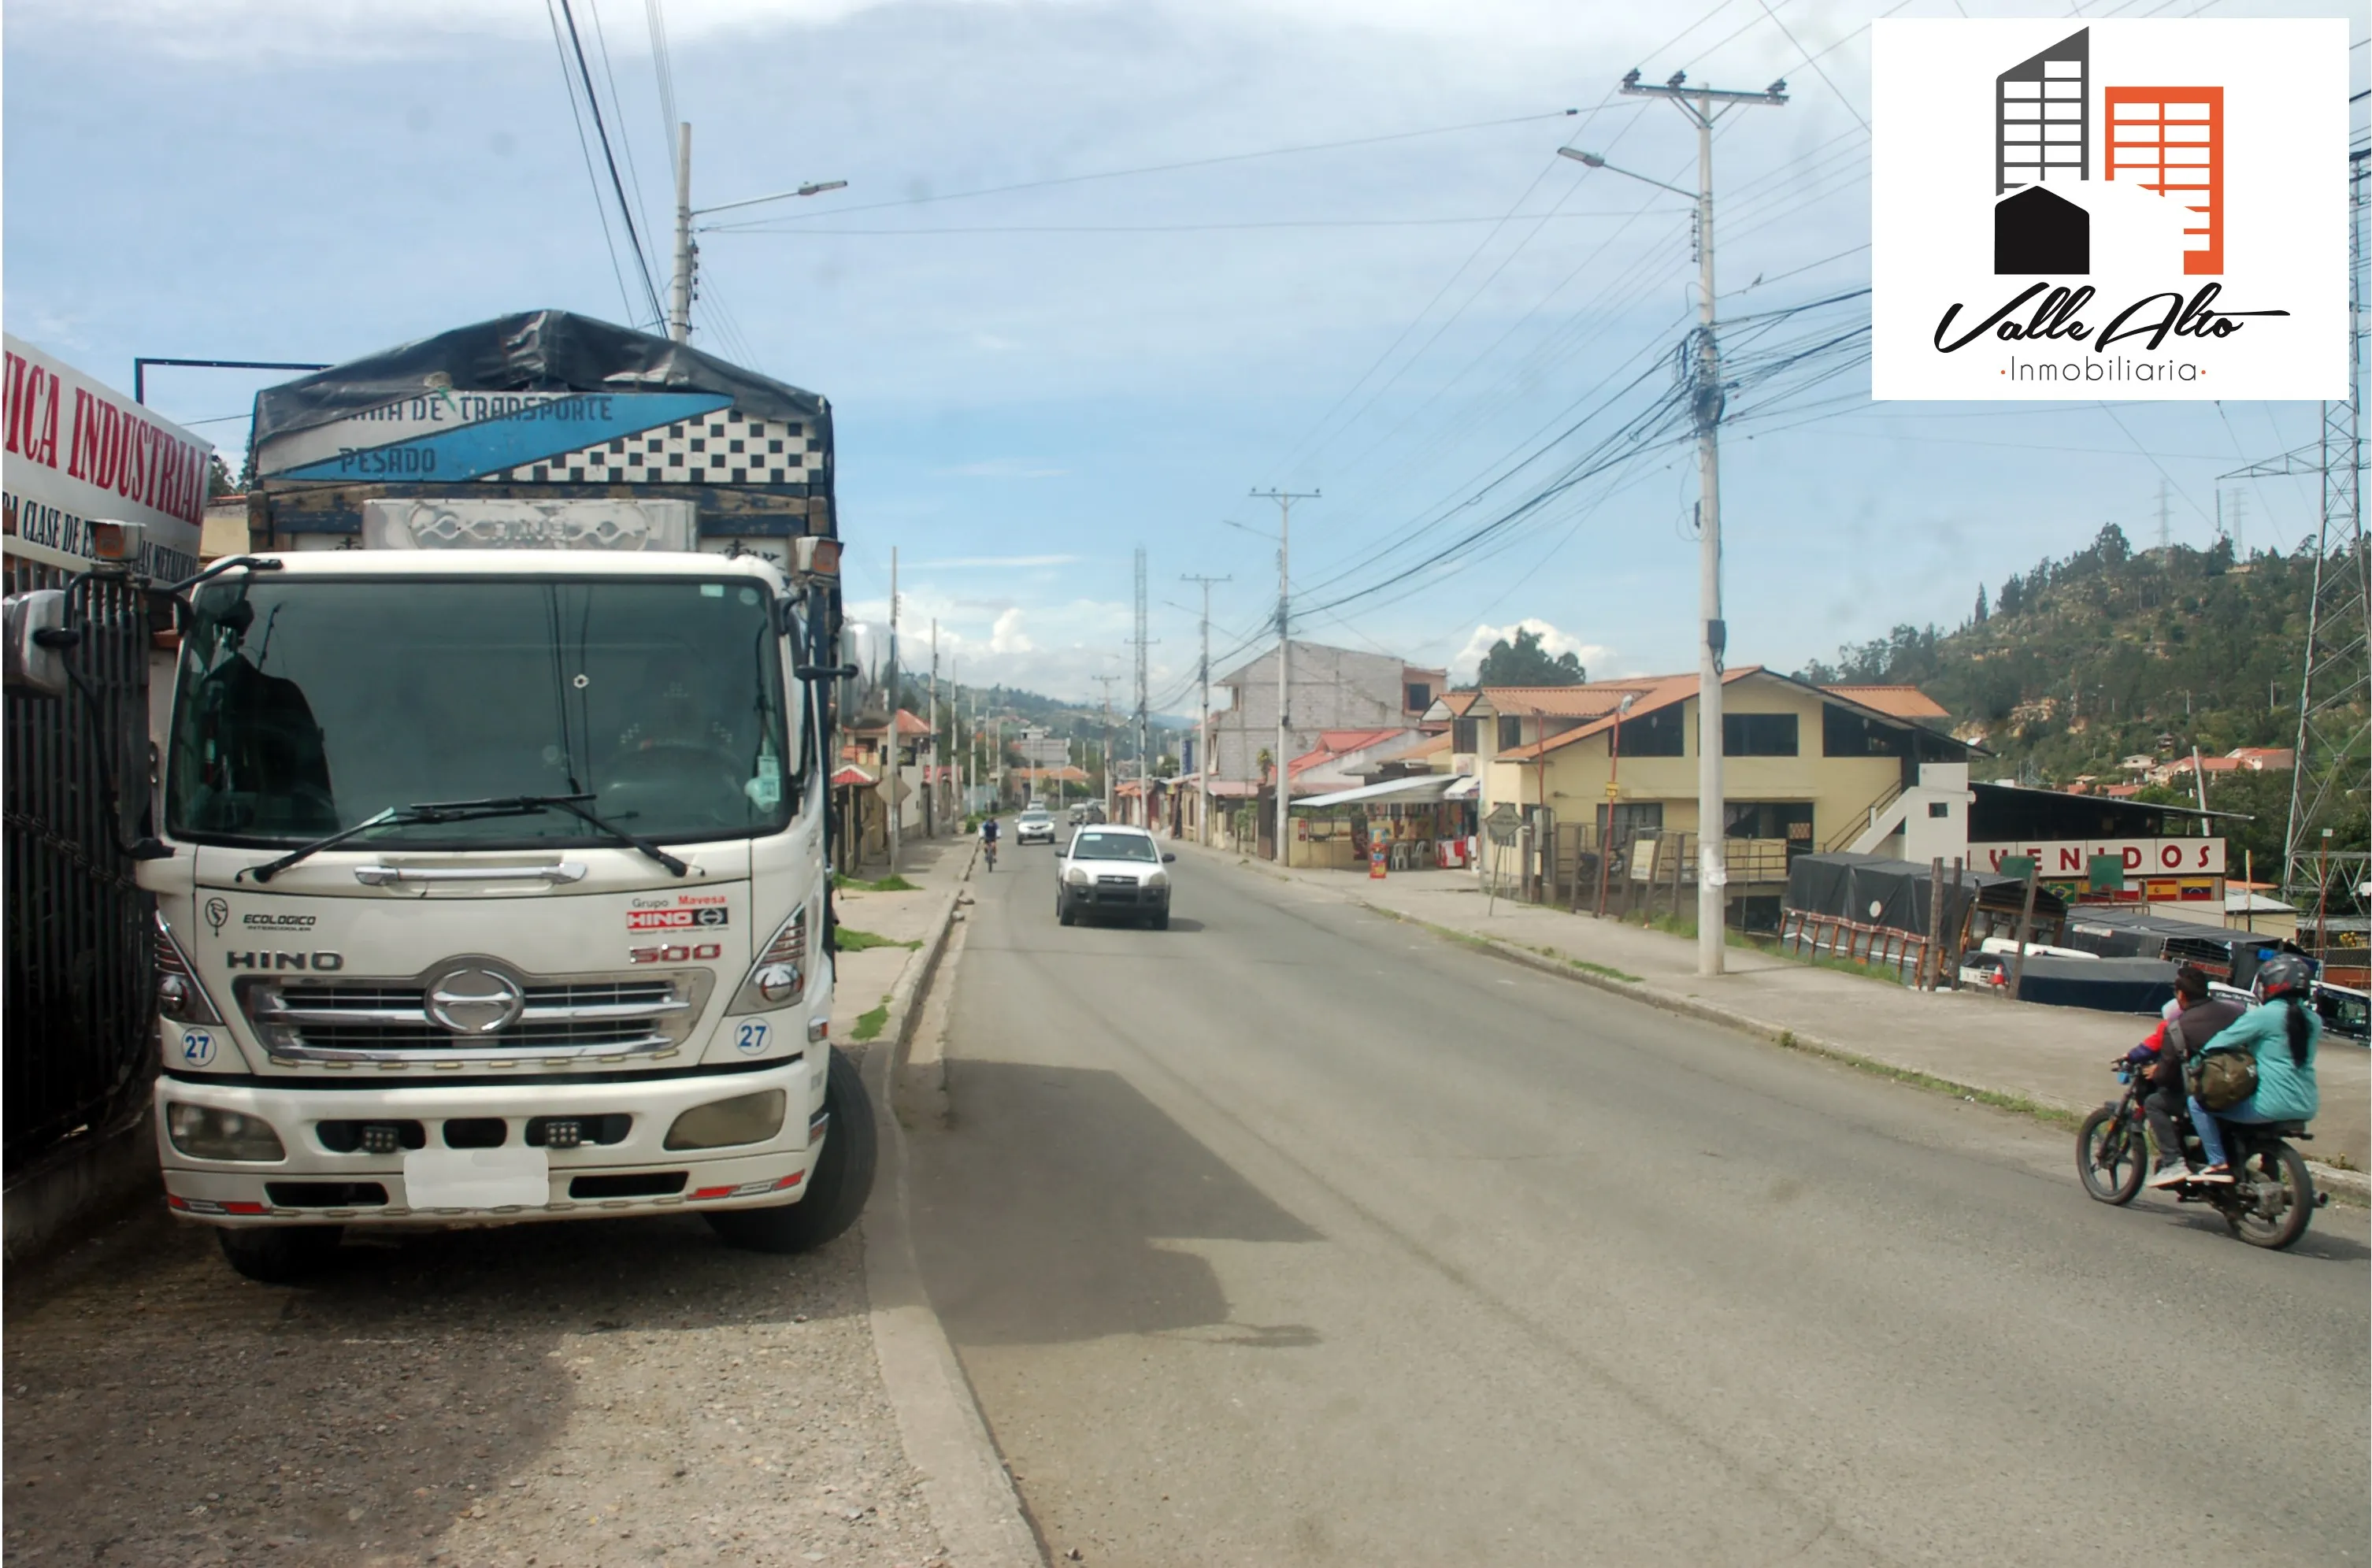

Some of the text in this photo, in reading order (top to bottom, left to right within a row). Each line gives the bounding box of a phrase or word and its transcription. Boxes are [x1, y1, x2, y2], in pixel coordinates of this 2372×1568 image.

[412, 397, 443, 421] DE
[460, 395, 613, 421] TRANSPORTE
[2, 350, 206, 526] ICA INDUSTRIAL
[339, 447, 435, 473] PESADO
[24, 499, 61, 549] CLASE
[62, 513, 81, 554] DE
[632, 895, 726, 910] Grupo Mavesa
[243, 914, 317, 925] ECOLOGICO
[628, 910, 693, 927] HINO
[226, 950, 344, 971] HINO
[630, 943, 721, 964] 500
[185, 1036, 209, 1058] 27
[739, 1025, 766, 1047] 27
